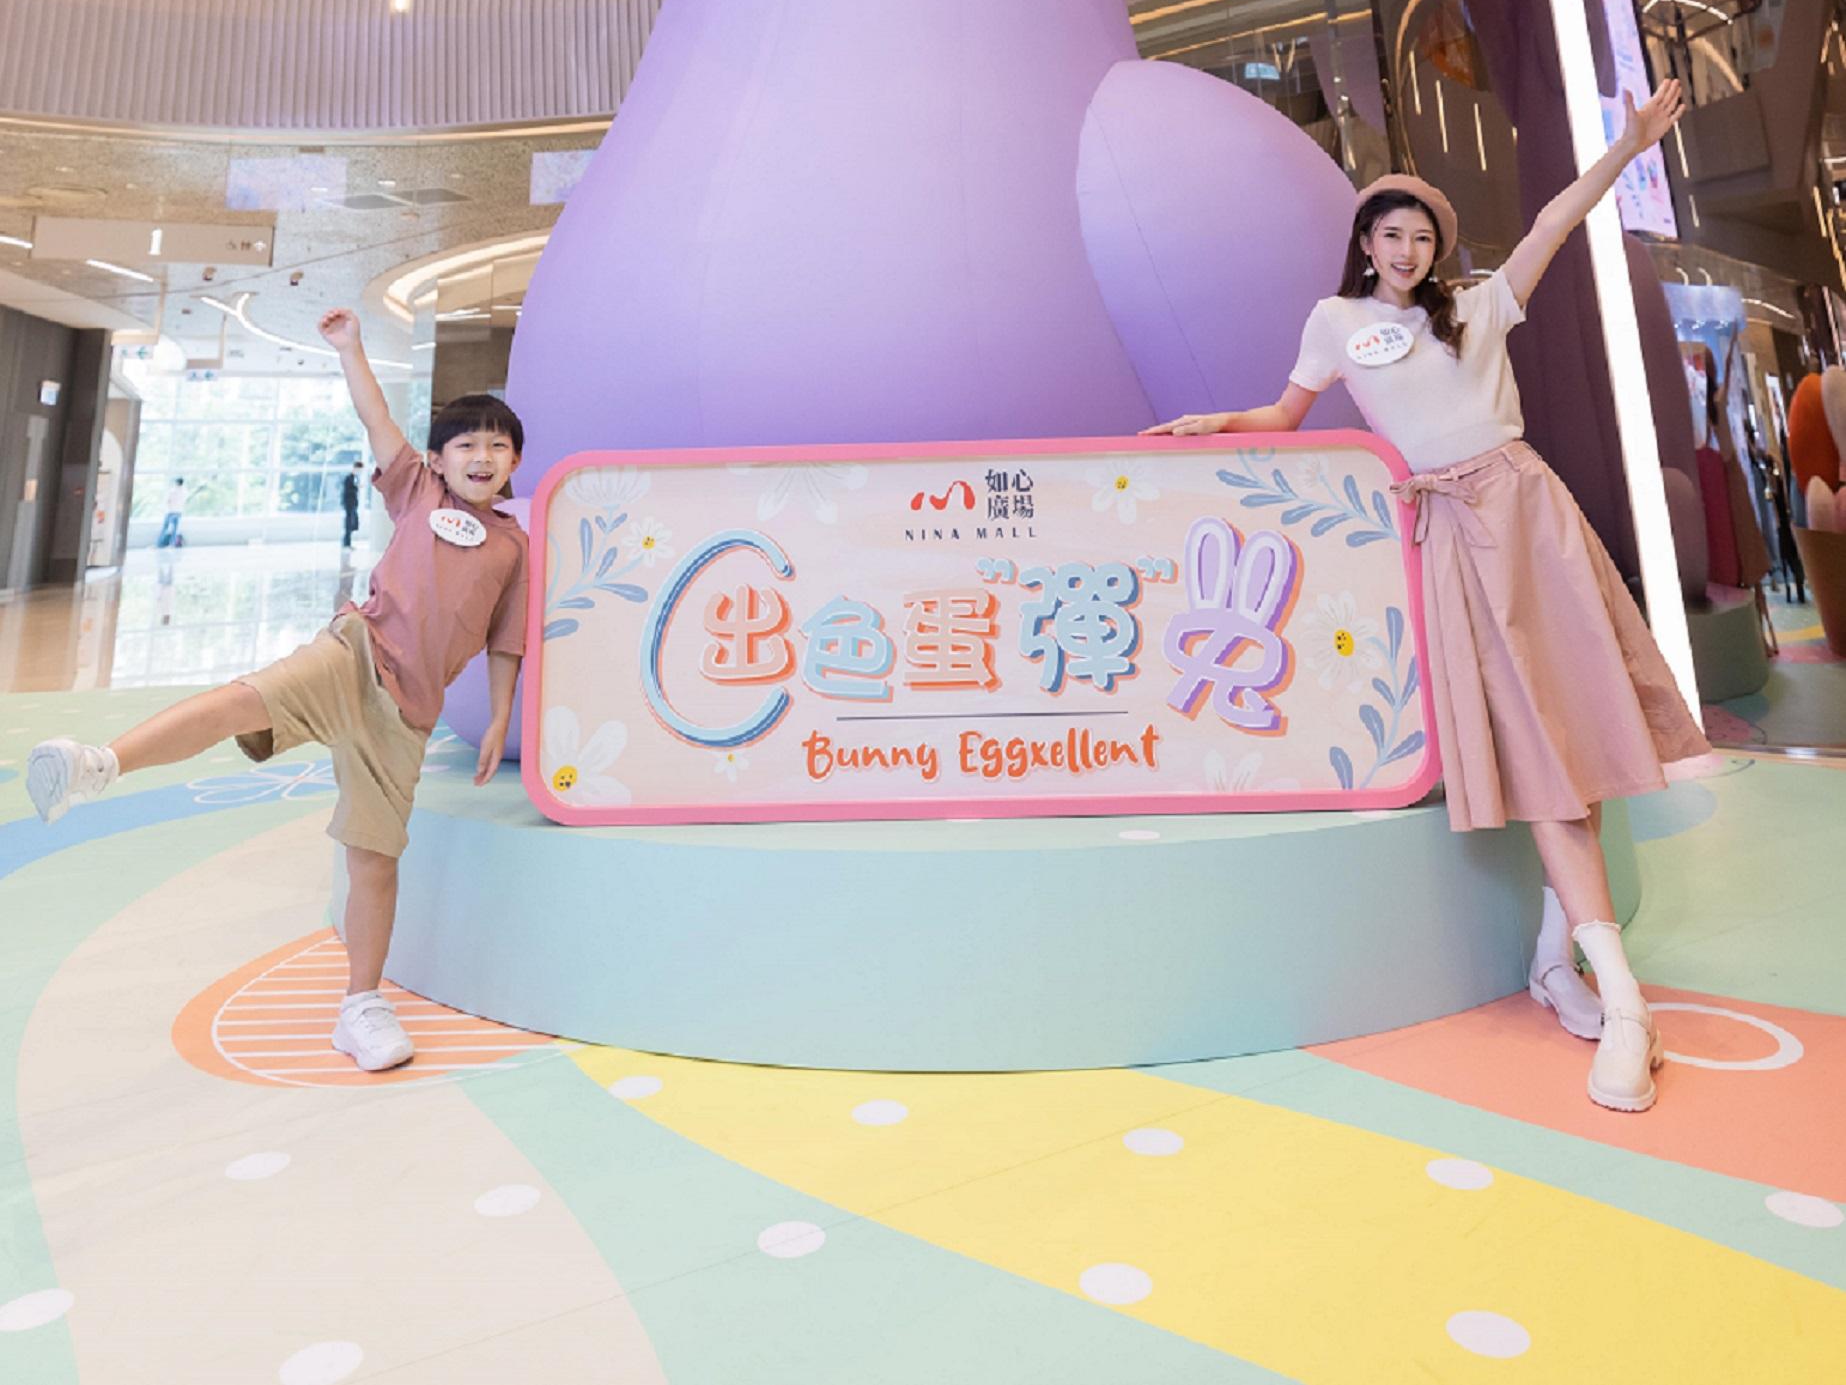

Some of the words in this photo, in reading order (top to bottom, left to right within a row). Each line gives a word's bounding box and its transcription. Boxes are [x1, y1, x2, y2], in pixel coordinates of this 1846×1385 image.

[985, 468, 1033, 492] 如心
[987, 494, 1034, 521] 廣場
[905, 528, 960, 540] NINA
[976, 527, 1036, 539] MALL
[802, 729, 938, 780] Bunny
[958, 723, 1160, 779] Eggxellent
